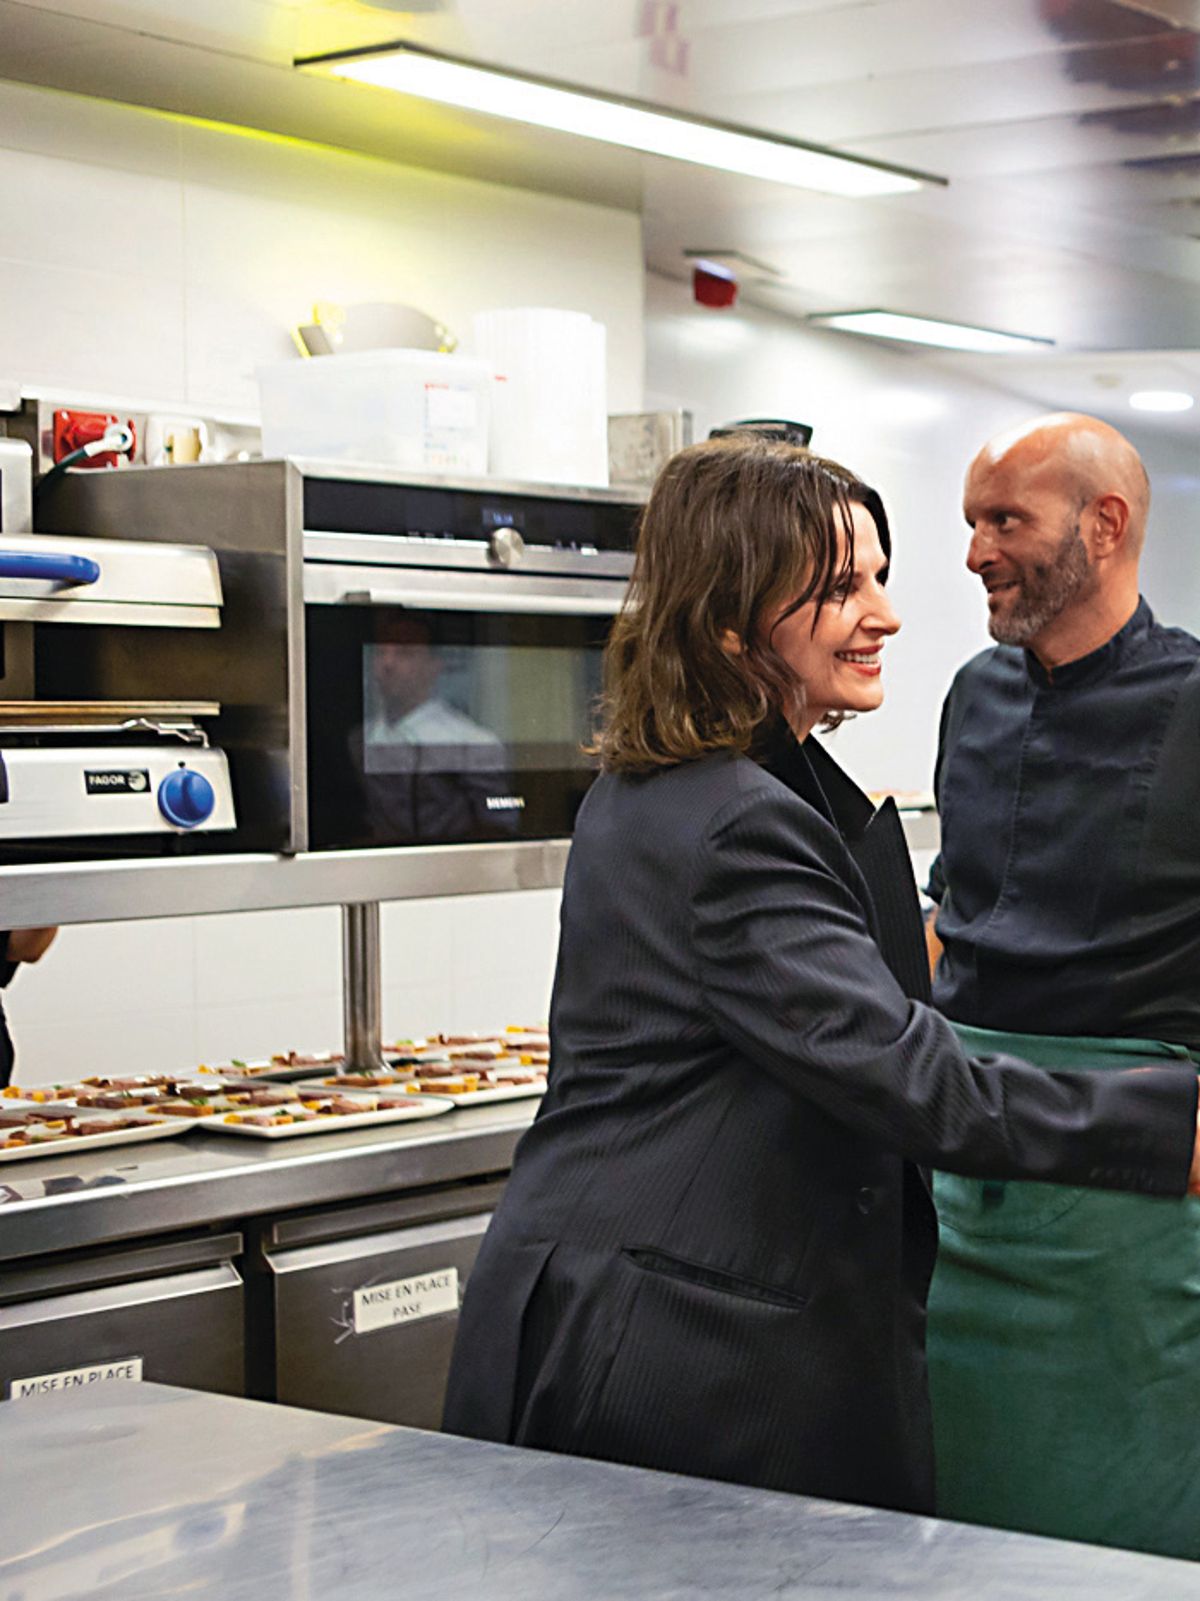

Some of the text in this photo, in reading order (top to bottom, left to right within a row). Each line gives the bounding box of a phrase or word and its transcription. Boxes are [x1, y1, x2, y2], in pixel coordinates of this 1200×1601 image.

[88, 773, 126, 786] FAGOR
[361, 1275, 450, 1306] MISE EN PLACE
